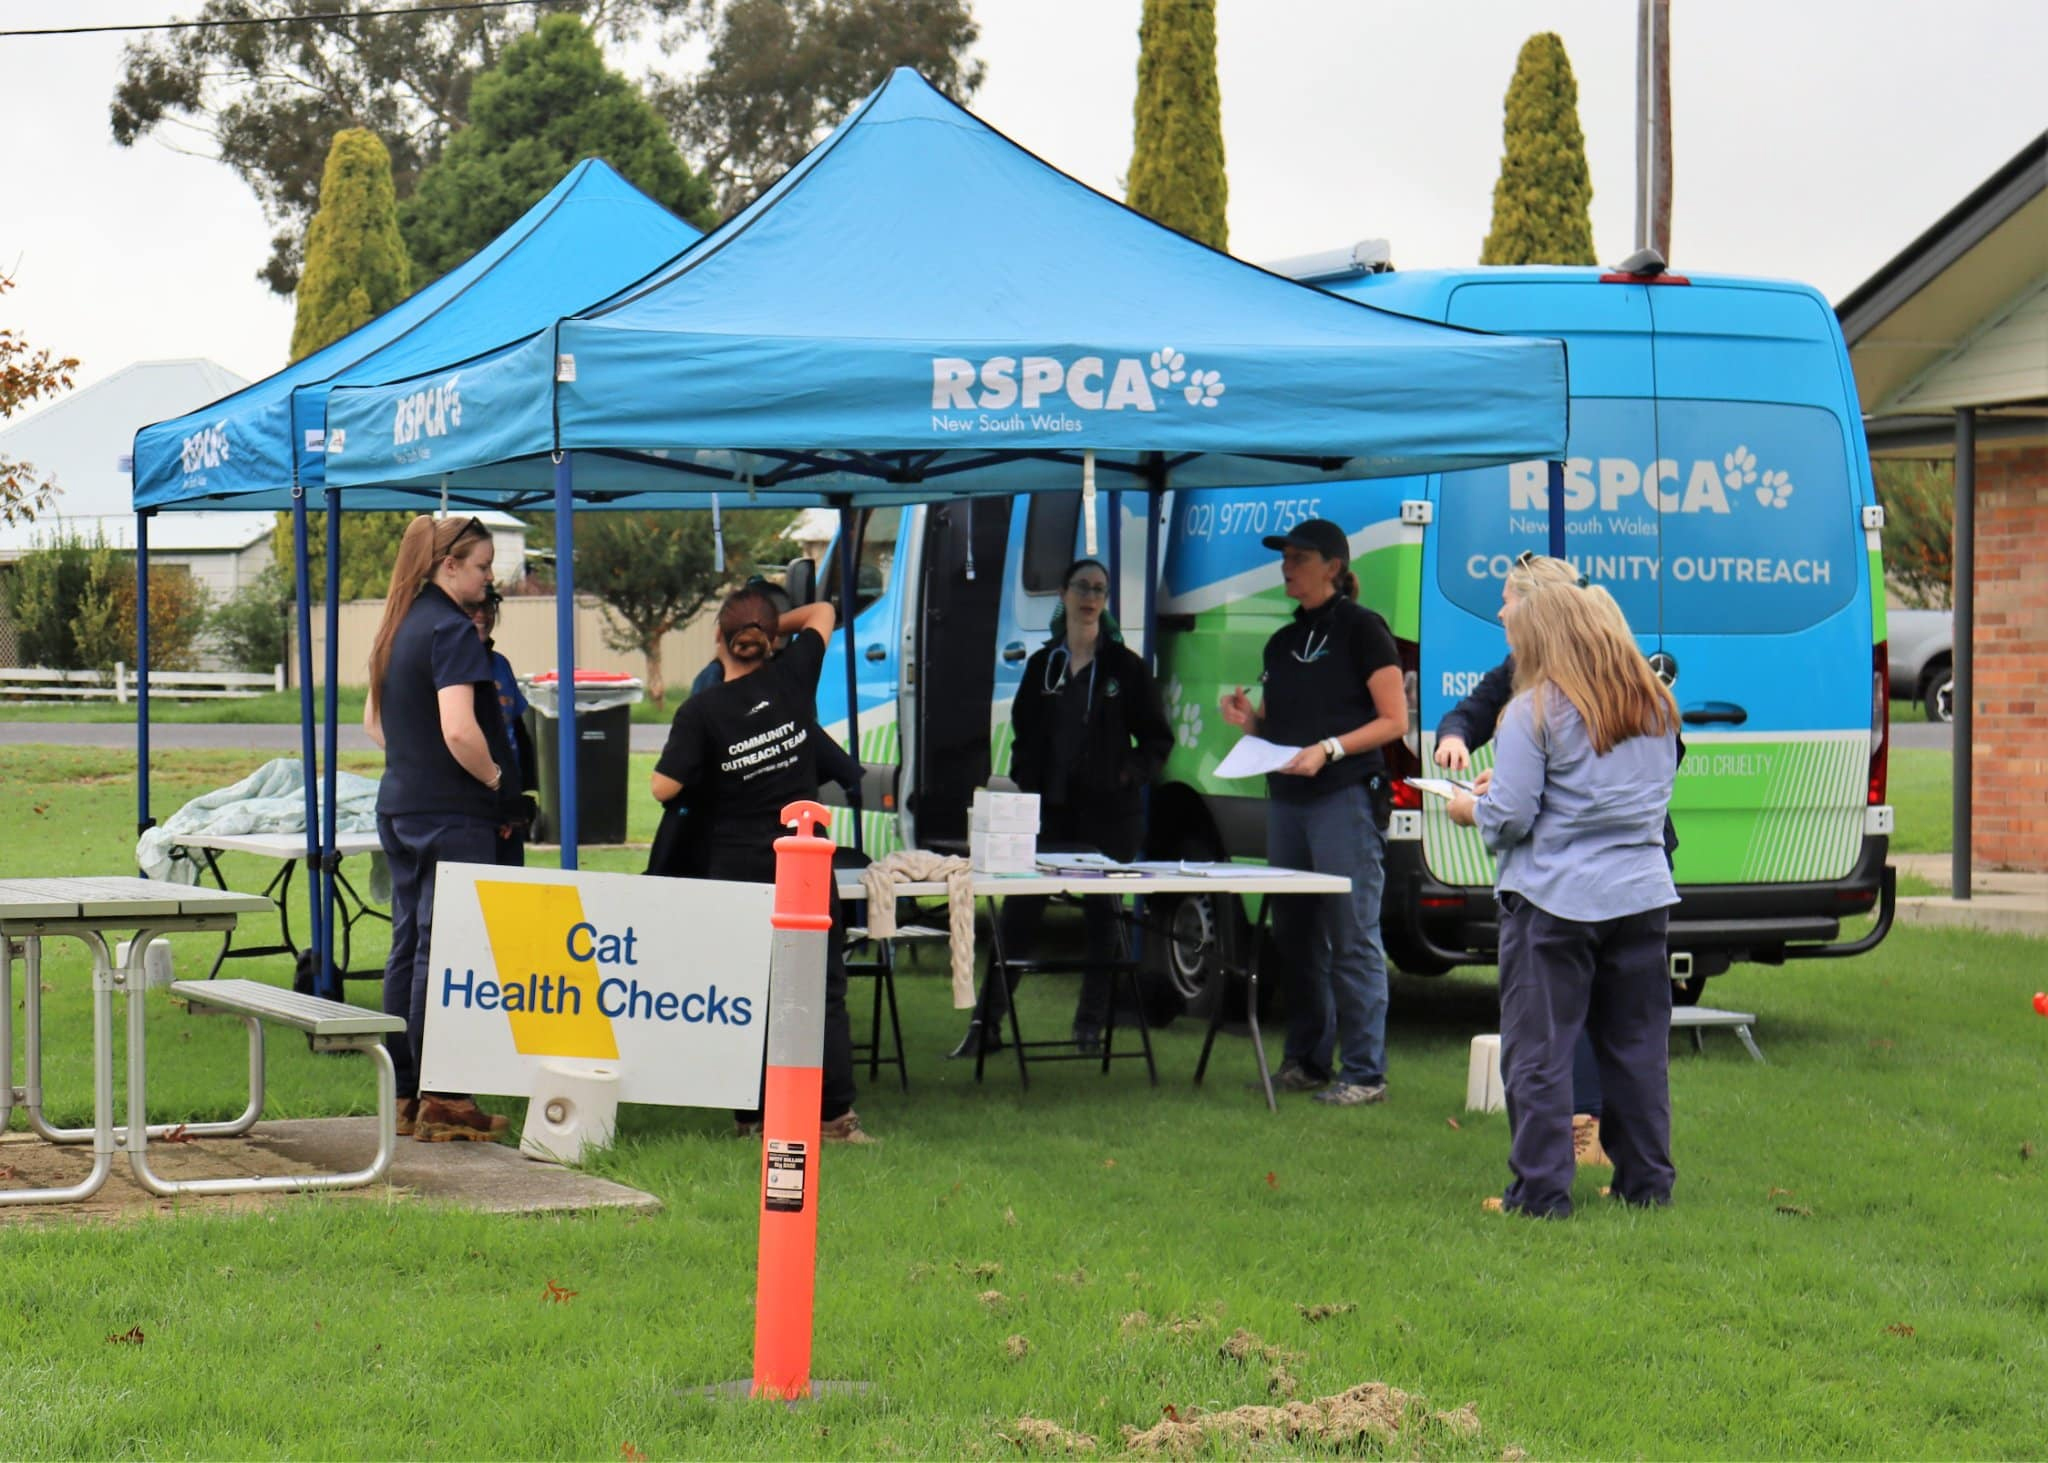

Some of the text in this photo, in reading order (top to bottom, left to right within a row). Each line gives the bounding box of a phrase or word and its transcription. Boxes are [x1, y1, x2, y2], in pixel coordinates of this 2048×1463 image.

[932, 356, 1157, 412] RSPCA
[393, 386, 447, 446] RSPCA
[931, 412, 1083, 432] New South Wales
[1509, 457, 1731, 515] RSPCA
[1219, 501, 1268, 536] 9770
[1509, 515, 1658, 537] New outh Wales
[1466, 554, 1831, 585] COUNITY OUTREACH
[721, 744, 781, 773] OUTREACH
[781, 729, 808, 751] TEAM
[728, 721, 796, 756] COMMUNITY
[1678, 753, 1773, 777] 300 CRUELTY
[565, 921, 639, 966] Cat
[441, 967, 753, 1027] Health Checks
